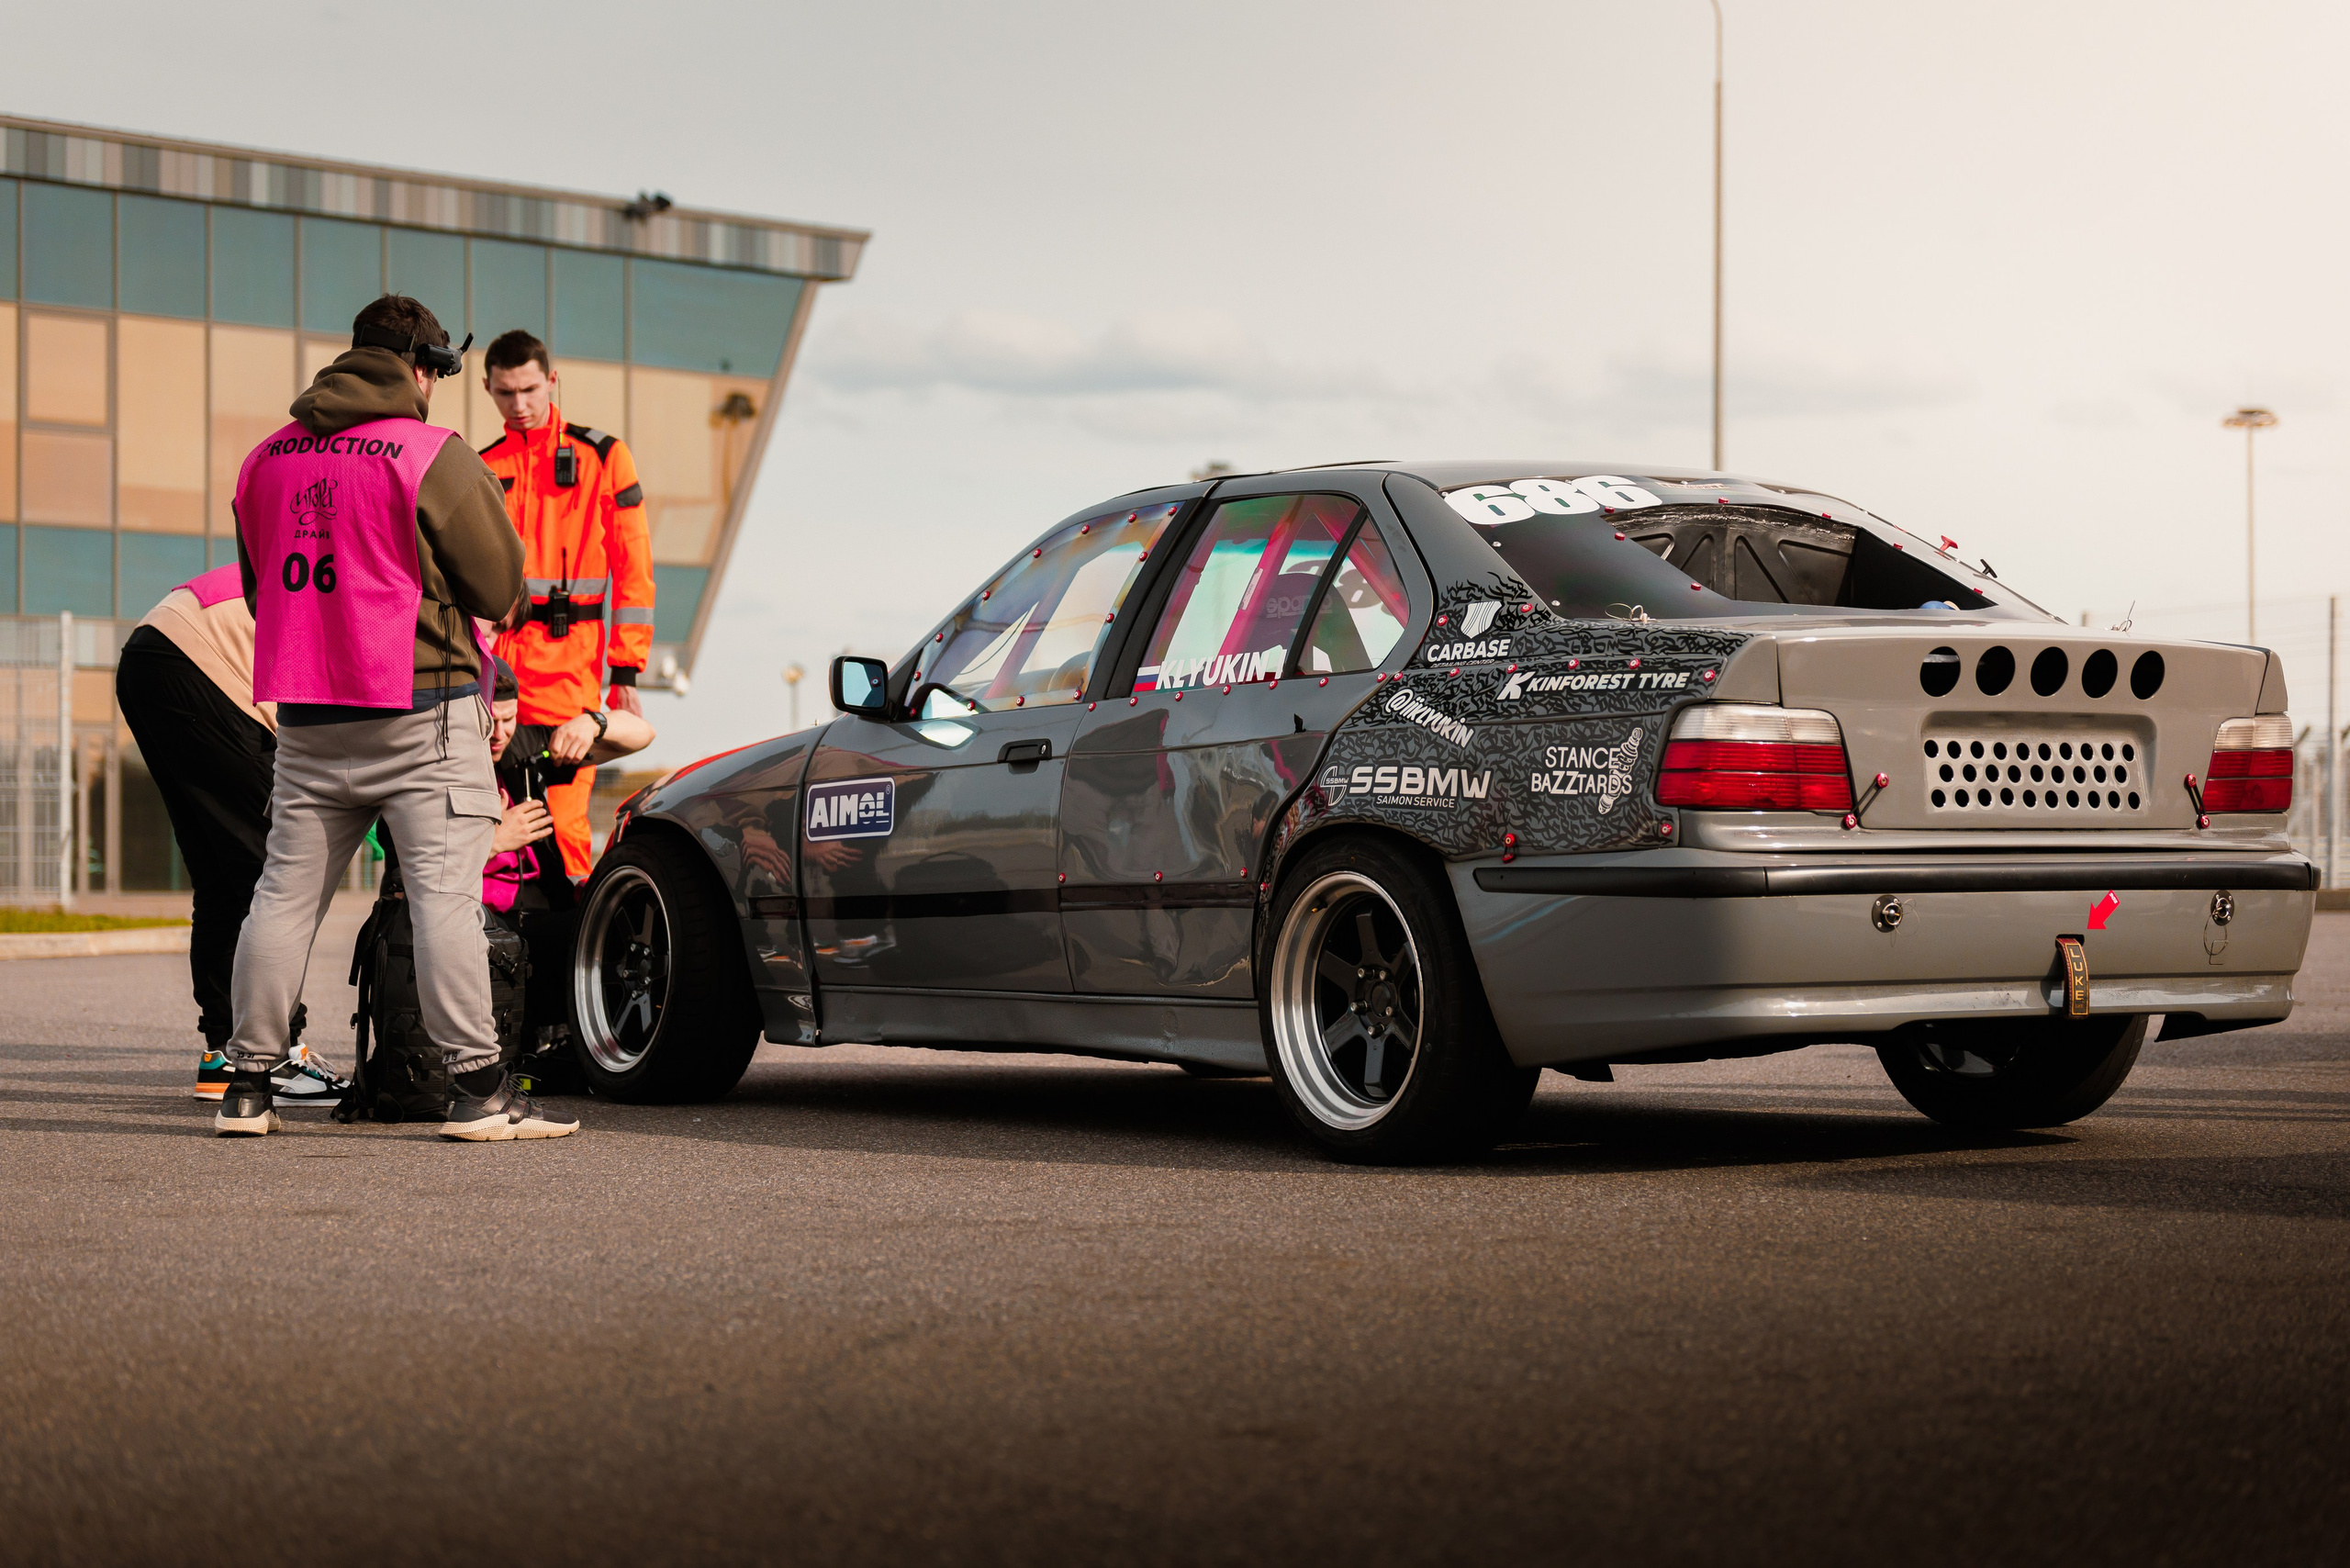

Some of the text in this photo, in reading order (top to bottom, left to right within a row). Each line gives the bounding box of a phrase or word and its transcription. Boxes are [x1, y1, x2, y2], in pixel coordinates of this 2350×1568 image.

[1444, 476, 1662, 525] 686
[282, 552, 336, 594] 06
[1427, 638, 1511, 663] CARBASE
[1466, 658, 1495, 666] CENTER
[1155, 650, 1270, 690] KLYUKIN
[1526, 673, 1634, 692] KINFOREST
[1639, 672, 1691, 689] TYRE
[1545, 745, 1622, 769] STANCE
[1349, 766, 1492, 799] SSBMW
[1531, 770, 1633, 795] BAZZTARDS
[810, 791, 890, 829] AIMOL
[1376, 795, 1455, 809] SAIMON SERVICE
[2069, 947, 2085, 1001] LUKE
